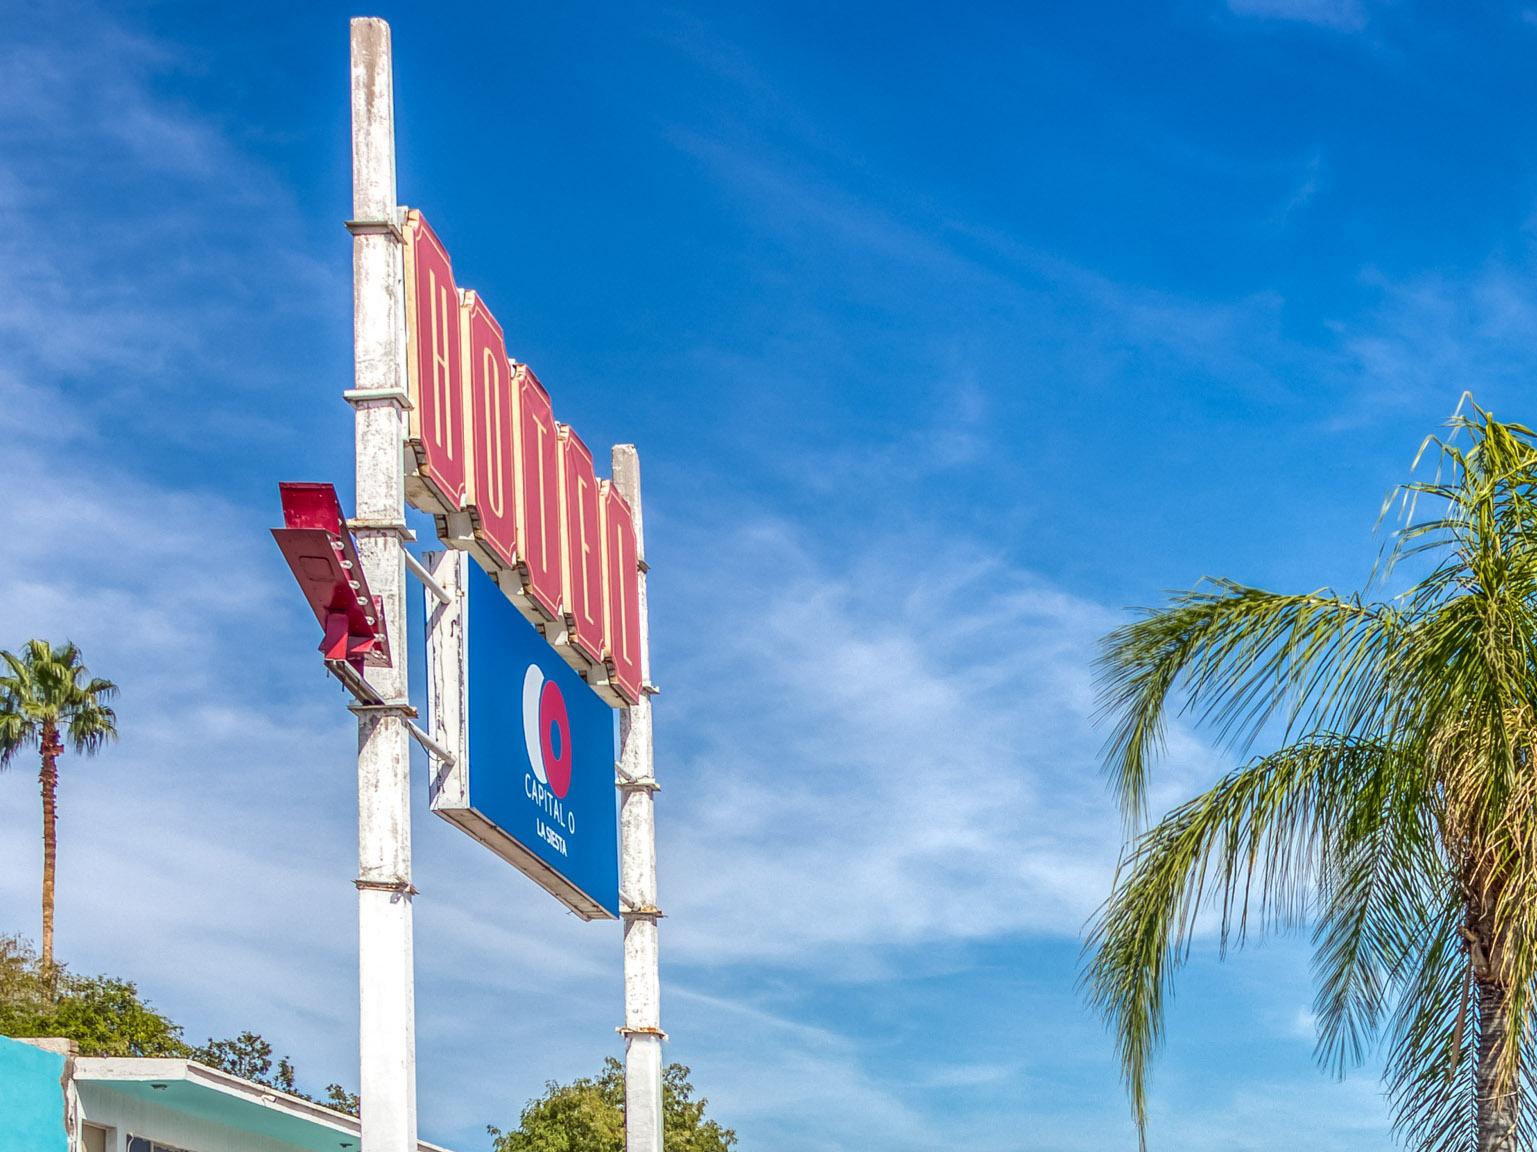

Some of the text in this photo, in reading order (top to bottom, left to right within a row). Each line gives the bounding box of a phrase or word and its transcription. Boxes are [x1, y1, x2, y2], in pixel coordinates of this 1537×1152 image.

[429, 268, 633, 666] HOTEL
[524, 773, 576, 835] CAPITAL O
[536, 817, 568, 857] LA SIESTA
